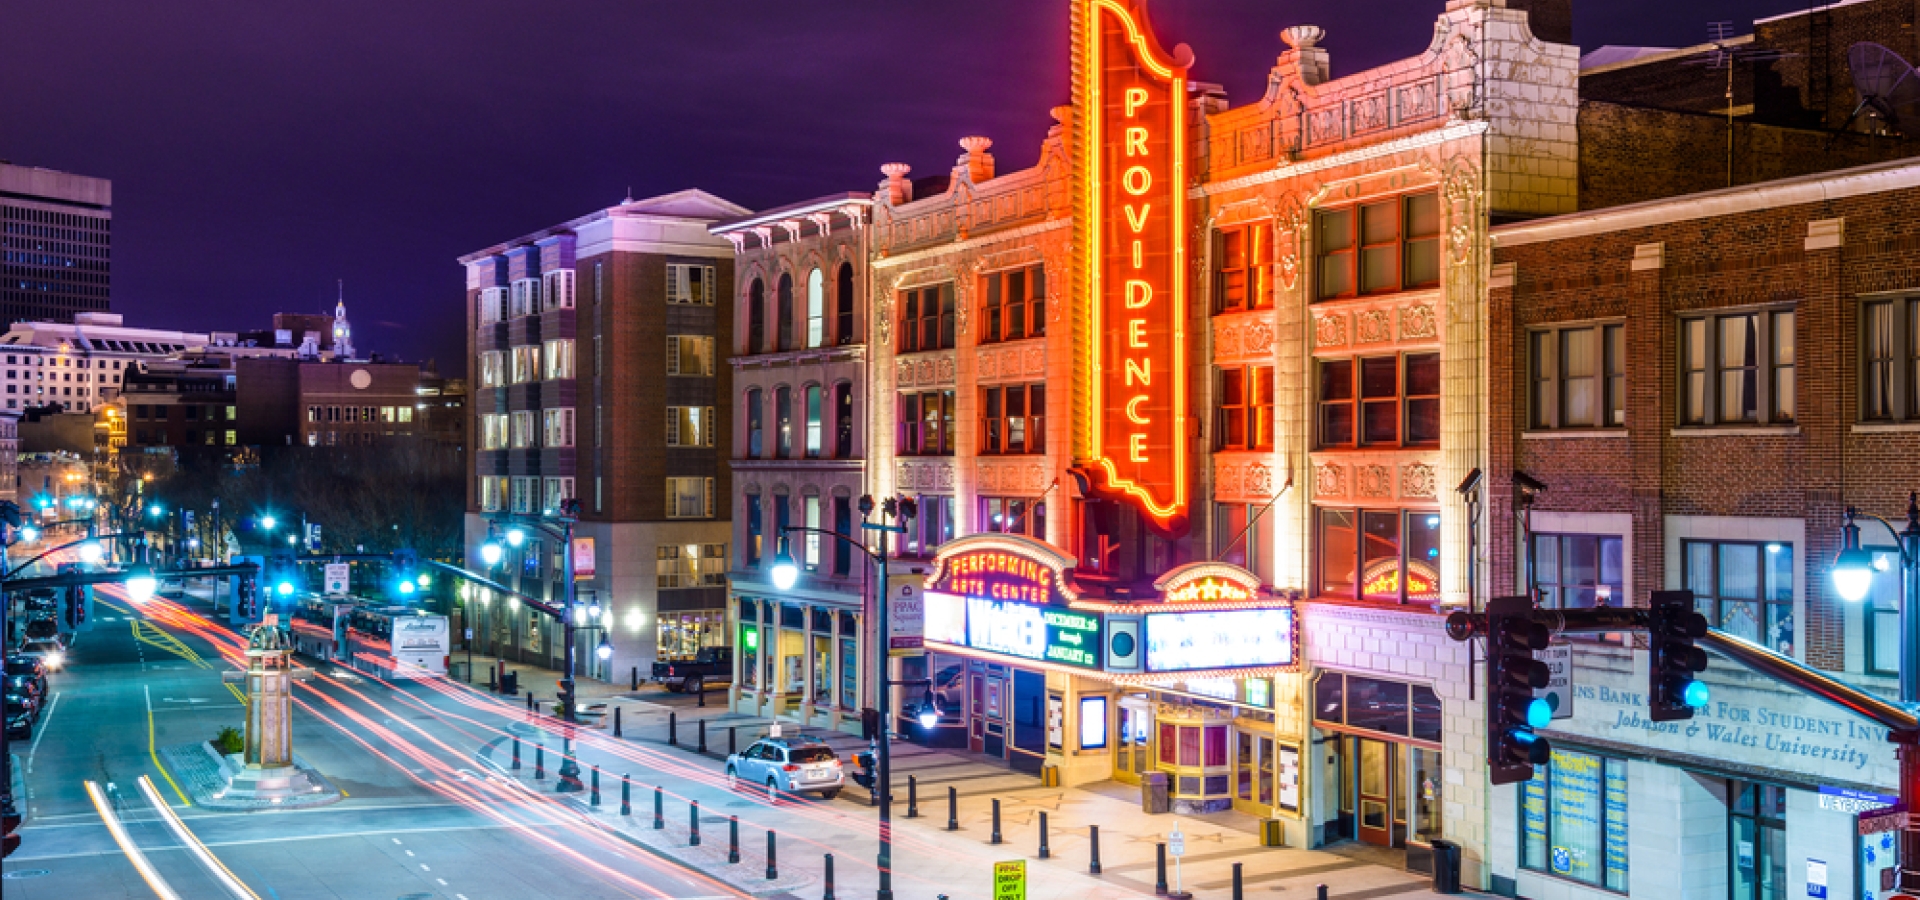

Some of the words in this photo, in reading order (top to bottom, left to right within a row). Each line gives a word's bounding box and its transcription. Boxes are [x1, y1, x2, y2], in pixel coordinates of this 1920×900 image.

[1122, 87, 1153, 463] PROVIDENCE
[951, 553, 1051, 586] PERFORMING
[951, 579, 986, 596] ARTS
[991, 582, 1051, 604] CENTER
[1044, 612, 1085, 629] DECEMBER
[1047, 644, 1084, 662] JANUARY
[1599, 685, 1642, 706] BANK
[1717, 701, 1750, 722] FOR
[1757, 707, 1842, 735] STUDENT
[1612, 709, 1679, 735] Johnson
[1685, 721, 1700, 737] &
[1706, 723, 1758, 747] Wales
[1766, 732, 1869, 770] University
[998, 874, 1022, 883] DROP
[1002, 884, 1018, 892] OFF
